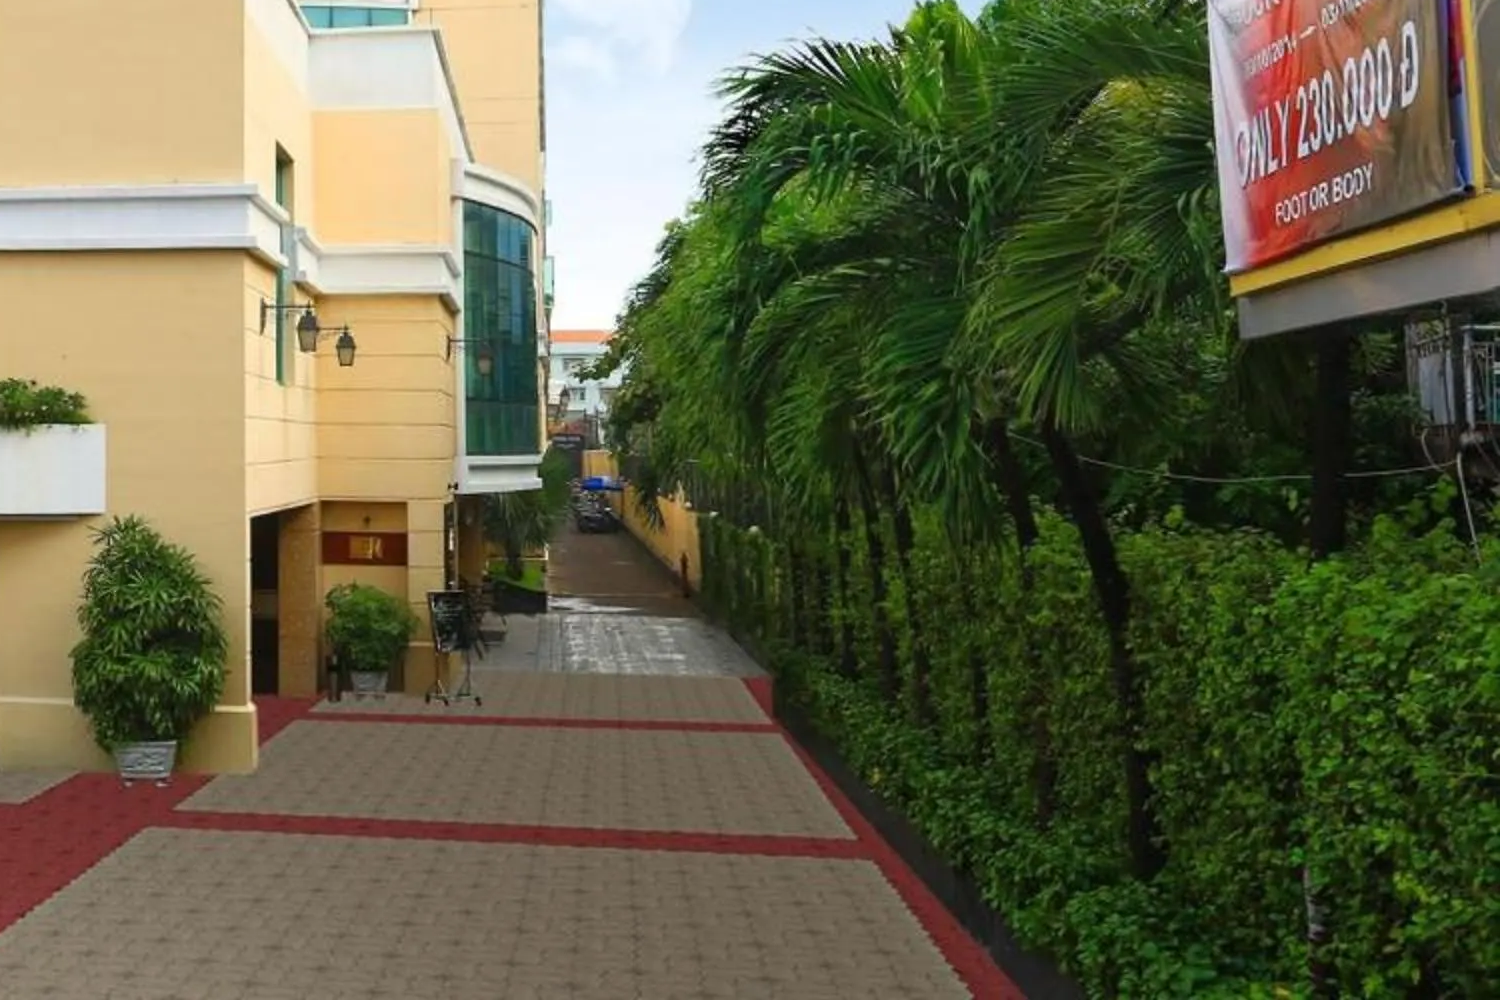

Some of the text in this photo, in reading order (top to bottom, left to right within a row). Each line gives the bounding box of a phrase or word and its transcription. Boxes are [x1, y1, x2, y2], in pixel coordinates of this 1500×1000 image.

[1236, 96, 1290, 189] ONLY
[1295, 37, 1393, 158] 230.000
[1275, 162, 1374, 226] FOOT OR BODY
